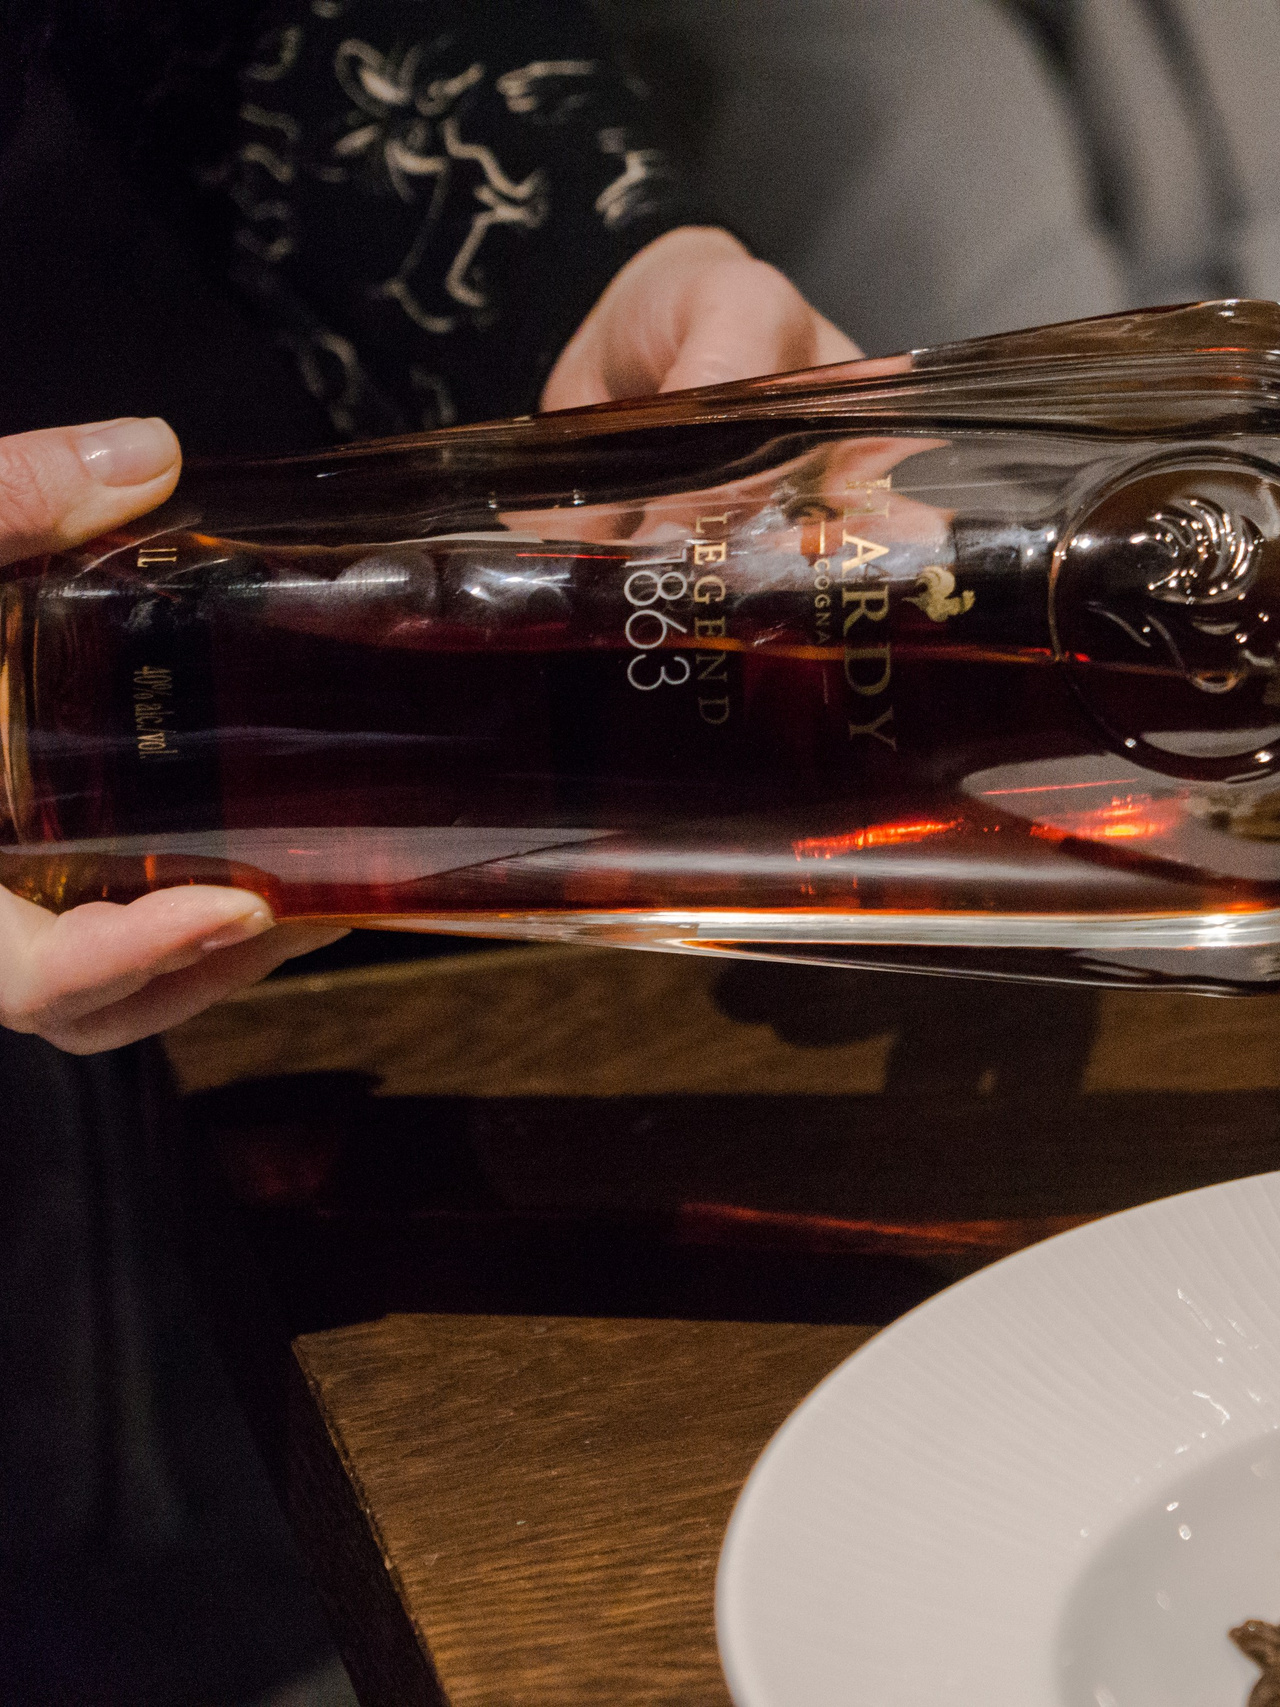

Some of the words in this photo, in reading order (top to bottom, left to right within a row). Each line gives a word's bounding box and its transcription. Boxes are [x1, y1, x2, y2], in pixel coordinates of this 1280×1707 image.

[623, 546, 691, 691] 1863
[693, 511, 730, 726] LEGEND
[813, 559, 832, 660] COGNA
[841, 473, 898, 751] HARDY
[133, 665, 174, 700] 40%
